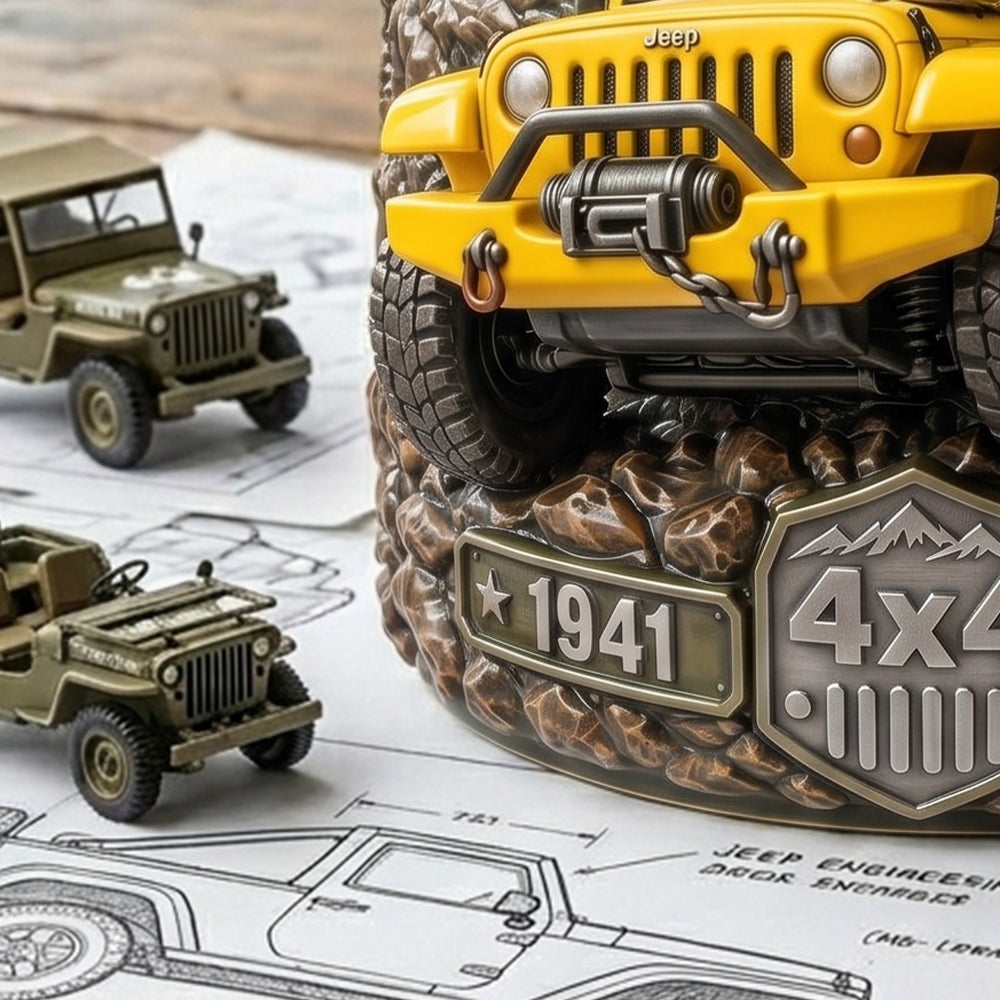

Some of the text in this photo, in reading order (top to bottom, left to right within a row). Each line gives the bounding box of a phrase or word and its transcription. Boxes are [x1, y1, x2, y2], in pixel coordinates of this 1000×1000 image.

[644, 27, 700, 53] Jeep
[527, 575, 676, 683] 1941
[713, 843, 803, 865] JEEP
